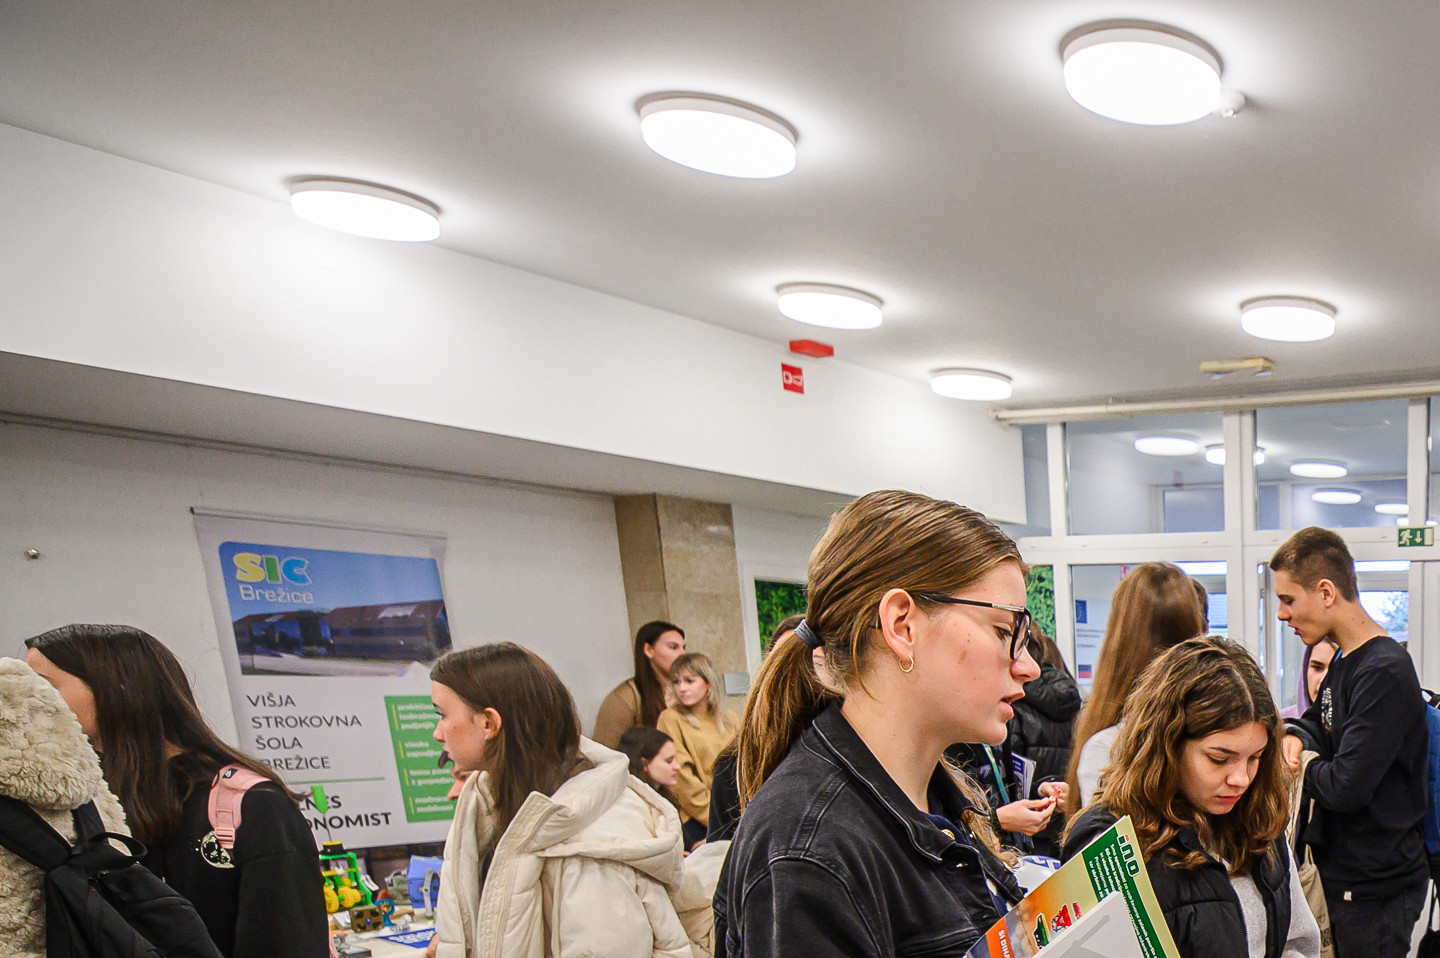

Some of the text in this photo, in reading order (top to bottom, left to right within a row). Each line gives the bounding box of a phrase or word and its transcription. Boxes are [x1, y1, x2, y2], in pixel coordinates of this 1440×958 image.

[233, 552, 311, 585] SIC
[238, 583, 314, 605] Brežice
[246, 692, 296, 708] VIŠJA
[251, 715, 362, 730] STROKOVNA
[256, 735, 304, 751] ŠOLA
